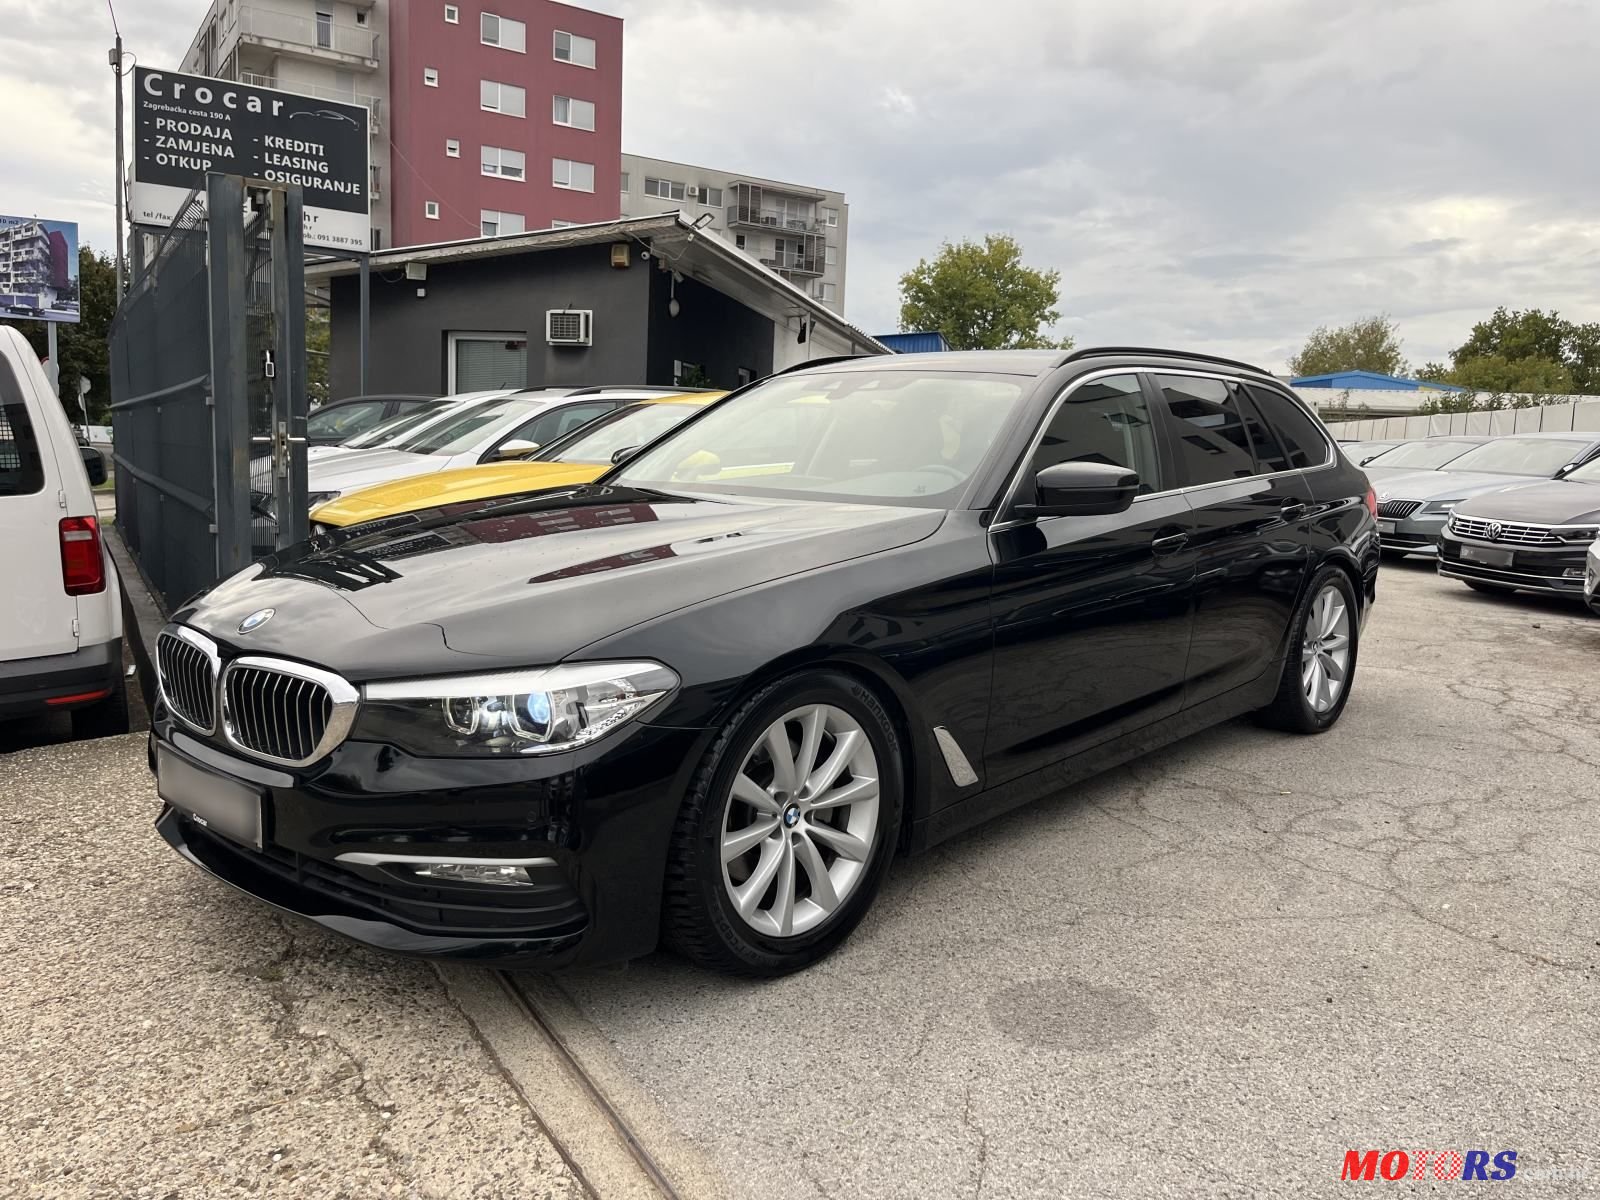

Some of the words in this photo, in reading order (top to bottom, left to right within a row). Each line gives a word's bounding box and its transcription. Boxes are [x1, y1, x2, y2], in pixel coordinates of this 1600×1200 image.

[143, 73, 284, 117] Crocar
[188, 109, 208, 118] cesta
[209, 111, 224, 120] 190
[224, 113, 231, 121] A
[156, 117, 233, 141] PRODAJA
[156, 135, 235, 159] ZAMJENA
[264, 134, 325, 157] KREDITI
[155, 153, 212, 171] OTKUP
[264, 152, 329, 174] LEASING
[264, 169, 361, 196] OSIGURANJE
[317, 234, 330, 242] 091
[332, 236, 349, 244] 3887
[350, 238, 363, 246] 395
